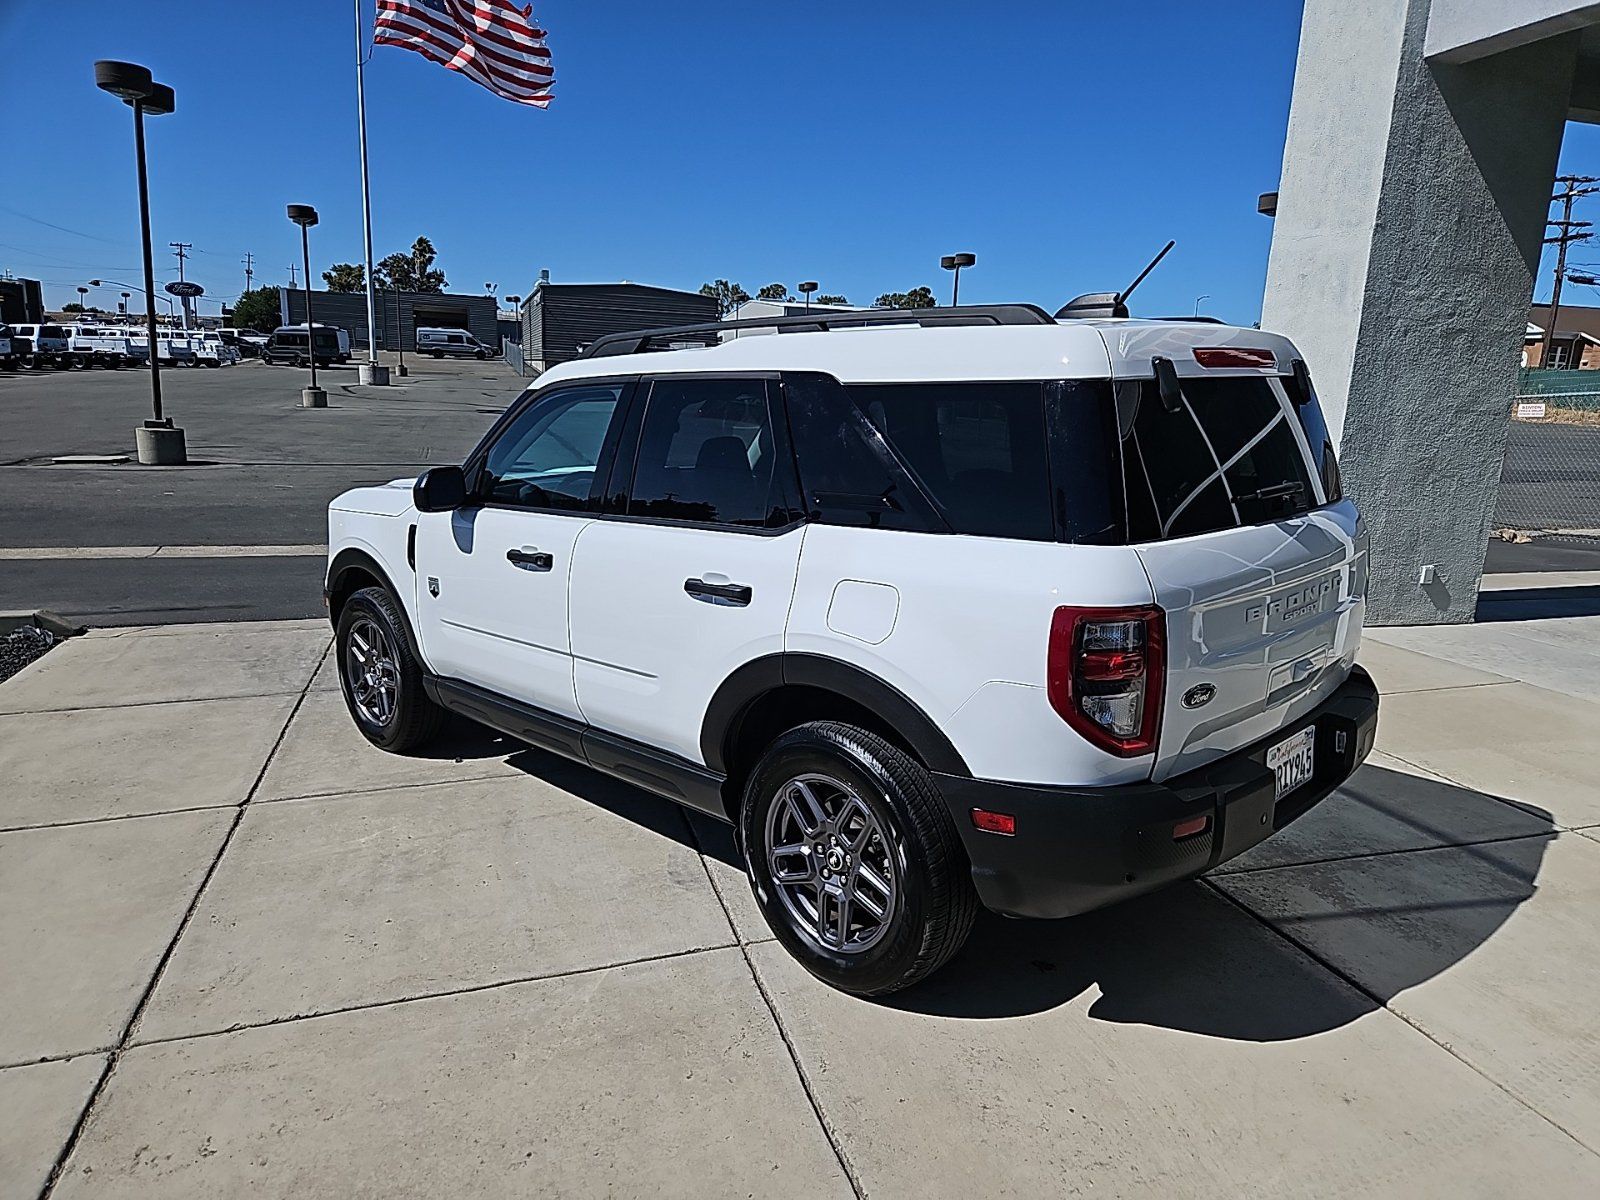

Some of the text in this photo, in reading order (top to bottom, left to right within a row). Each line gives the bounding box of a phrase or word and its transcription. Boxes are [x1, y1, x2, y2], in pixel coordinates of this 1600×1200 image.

[173, 284, 196, 294] Ford
[1245, 574, 1342, 622] BRONCO
[1283, 600, 1319, 621] SPORT
[1191, 689, 1211, 705] Ford
